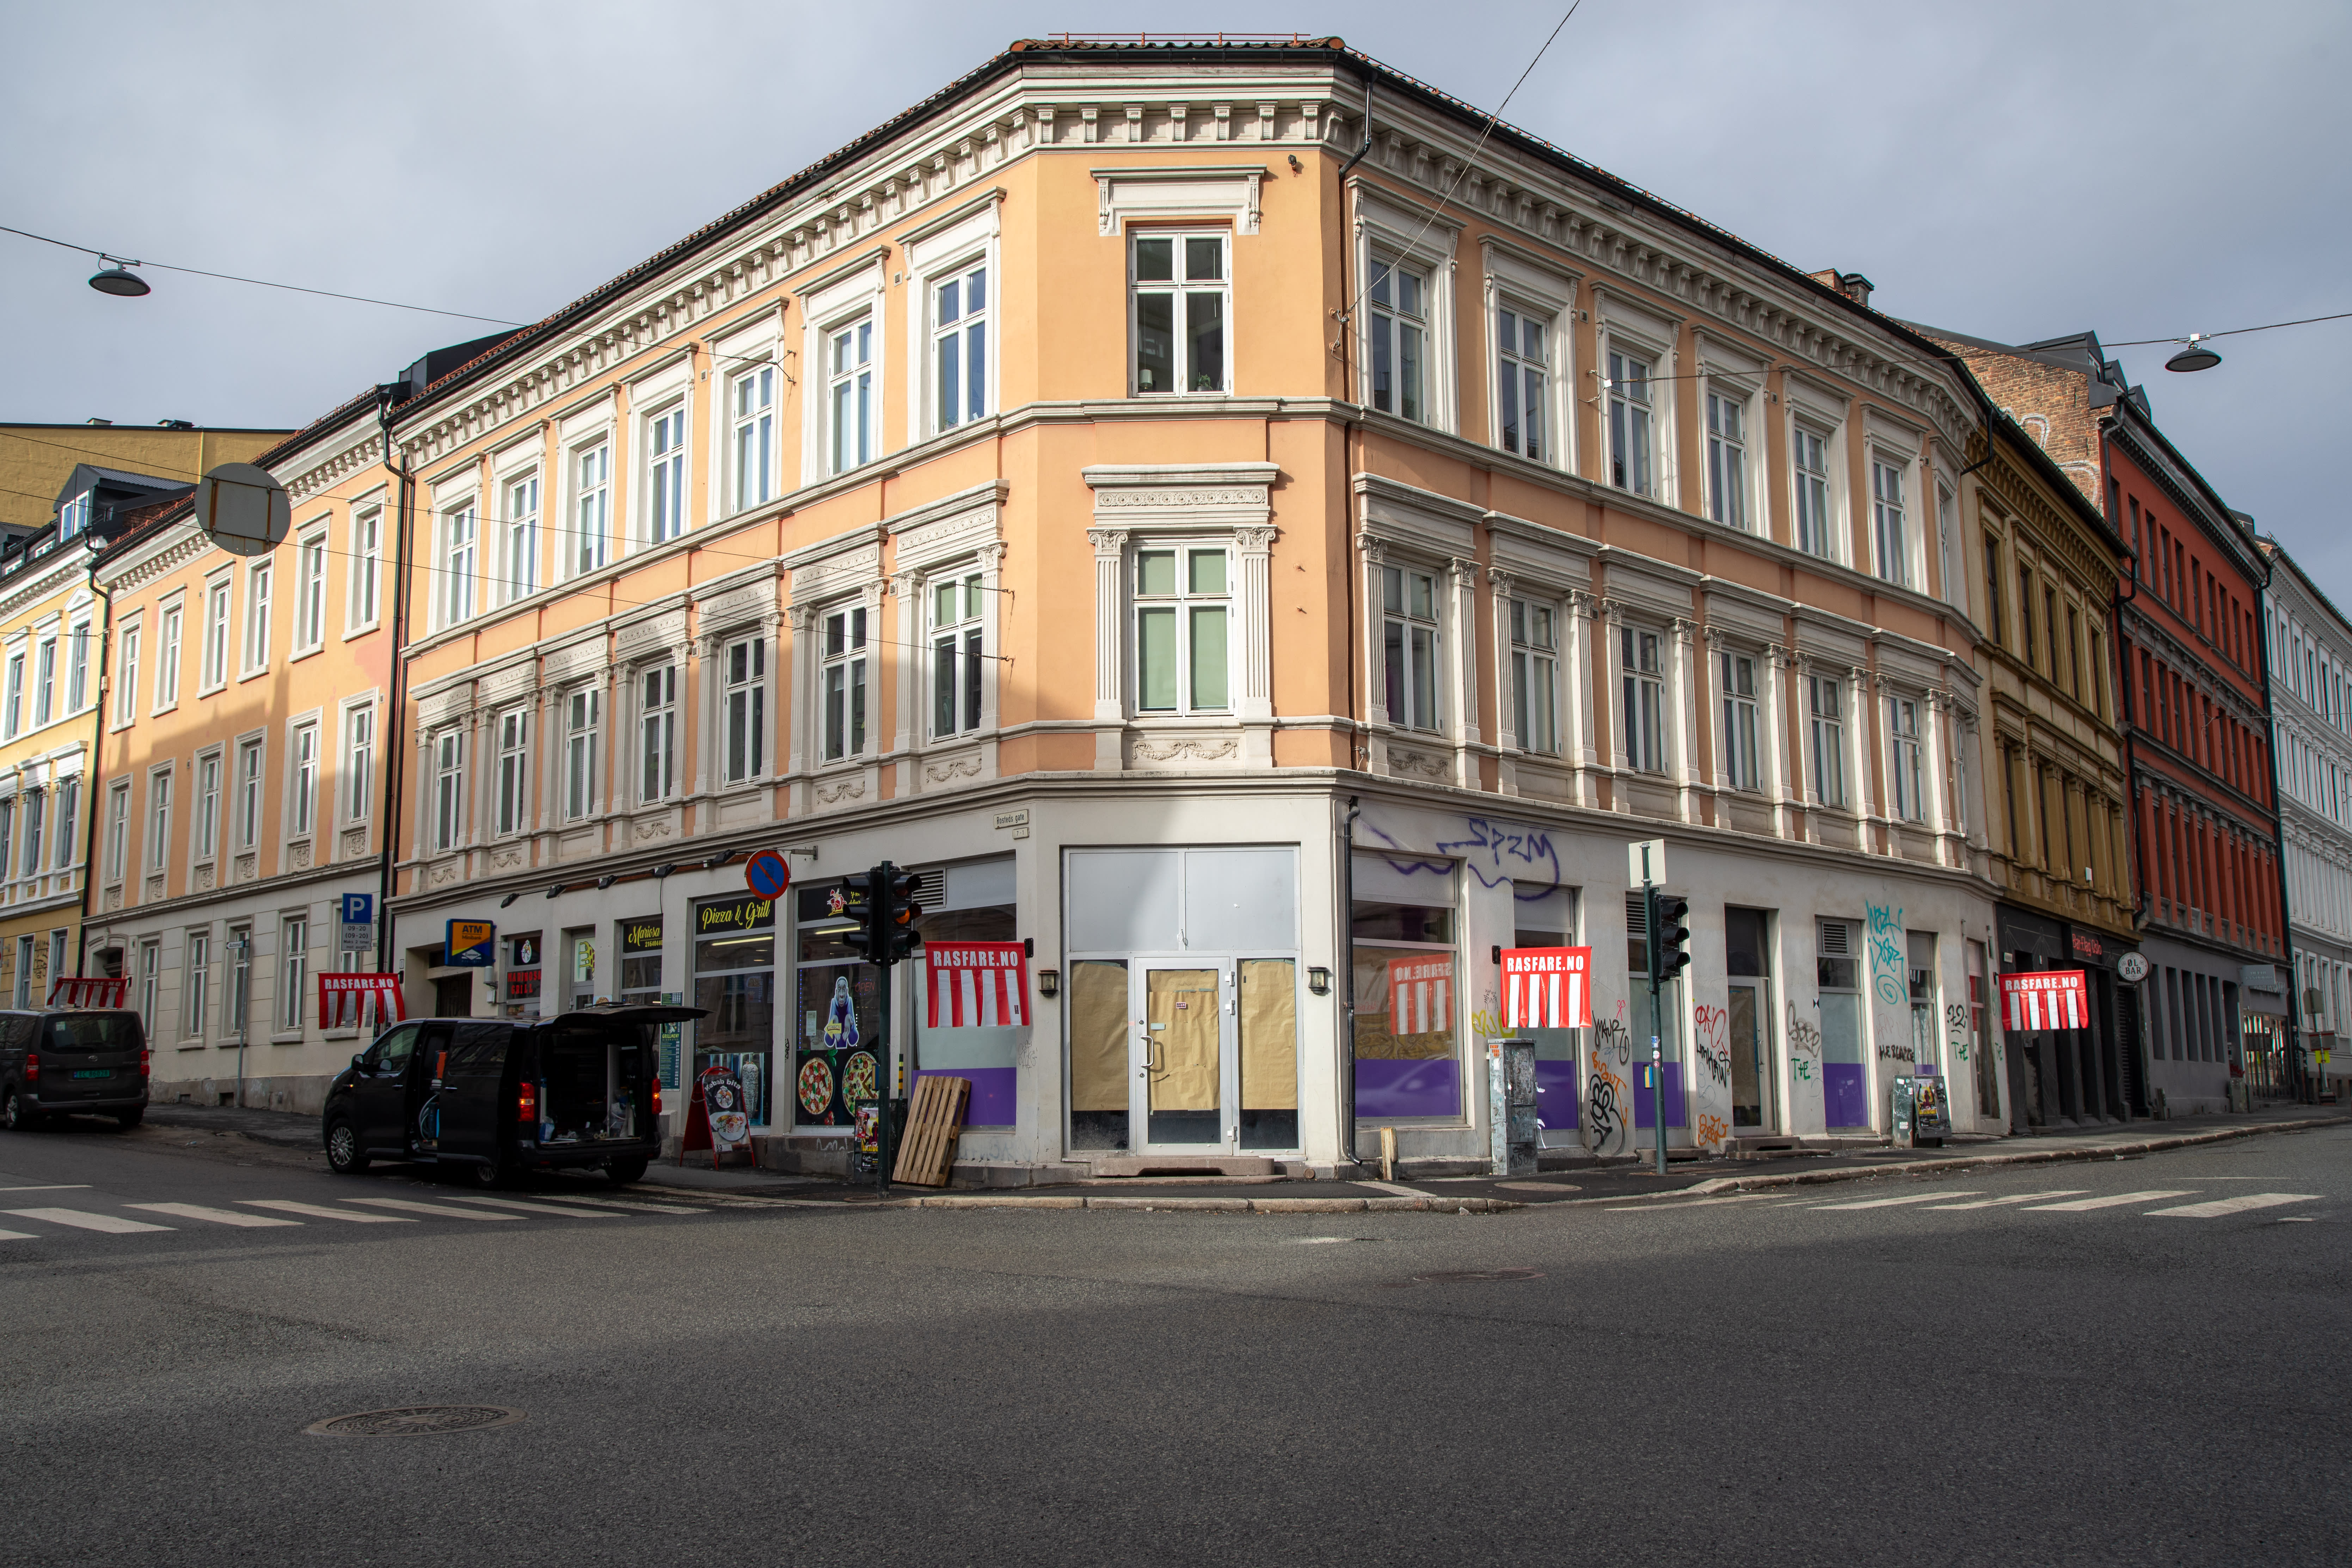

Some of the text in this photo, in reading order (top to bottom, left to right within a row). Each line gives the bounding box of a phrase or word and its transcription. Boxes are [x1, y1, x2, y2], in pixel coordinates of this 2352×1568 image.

[996, 813, 1024, 824] Rosteds gate
[350, 897, 365, 919] P
[702, 900, 770, 930] Pizza & Grill
[462, 925, 483, 933] ATM
[933, 951, 1018, 967] RASFARE.NO
[1507, 955, 1584, 972] RASFARE.NO
[324, 978, 394, 990] RASFARE.NO
[511, 983, 533, 995] GRILL
[855, 982, 875, 992] OPEN
[2005, 976, 2078, 991] RASFARE.NO
[704, 1078, 741, 1092] Kebab bita
